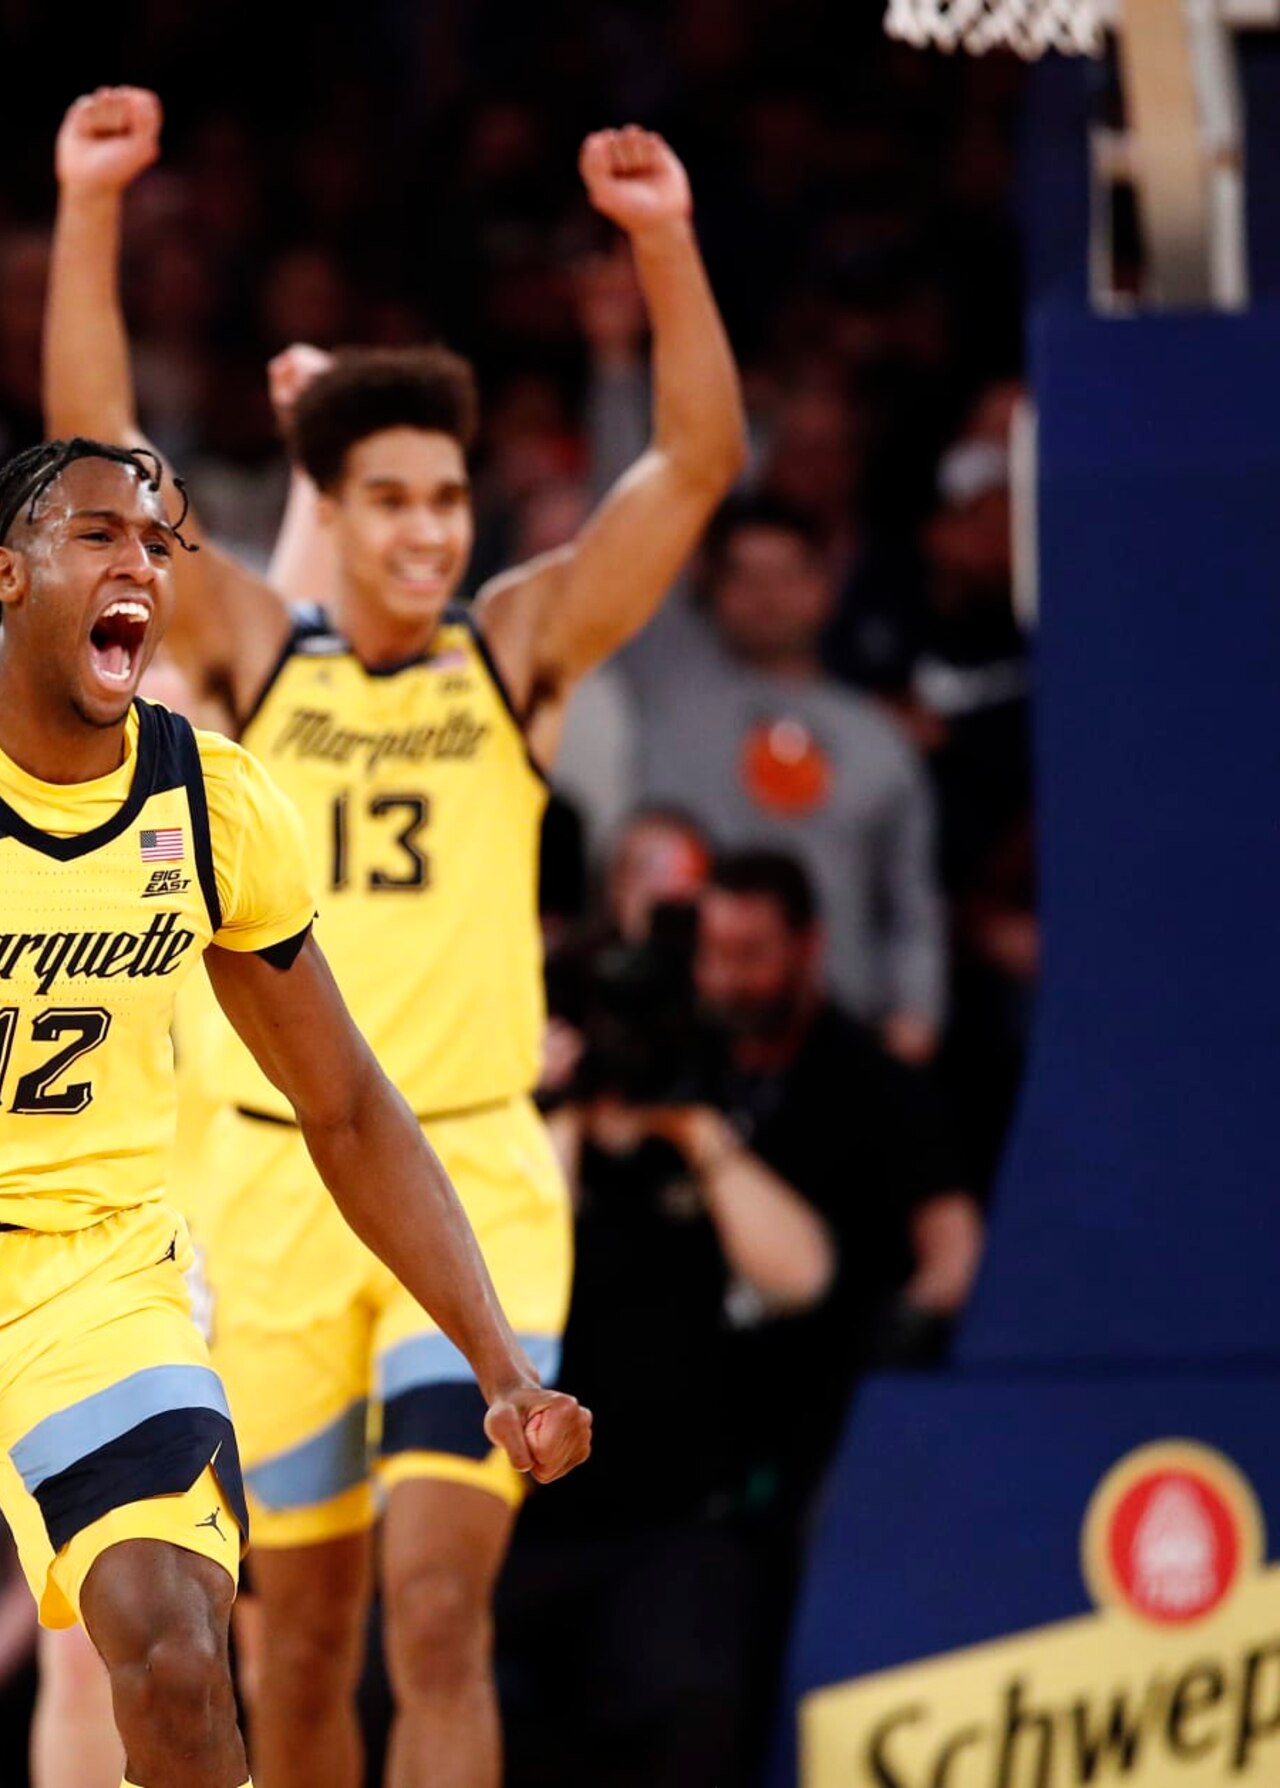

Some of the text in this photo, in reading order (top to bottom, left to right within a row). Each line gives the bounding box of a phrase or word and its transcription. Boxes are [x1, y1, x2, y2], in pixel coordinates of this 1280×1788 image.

[271, 707, 492, 778] Marquette
[331, 786, 432, 893] 13
[144, 880, 191, 893] EAST
[150, 869, 182, 881] BIG
